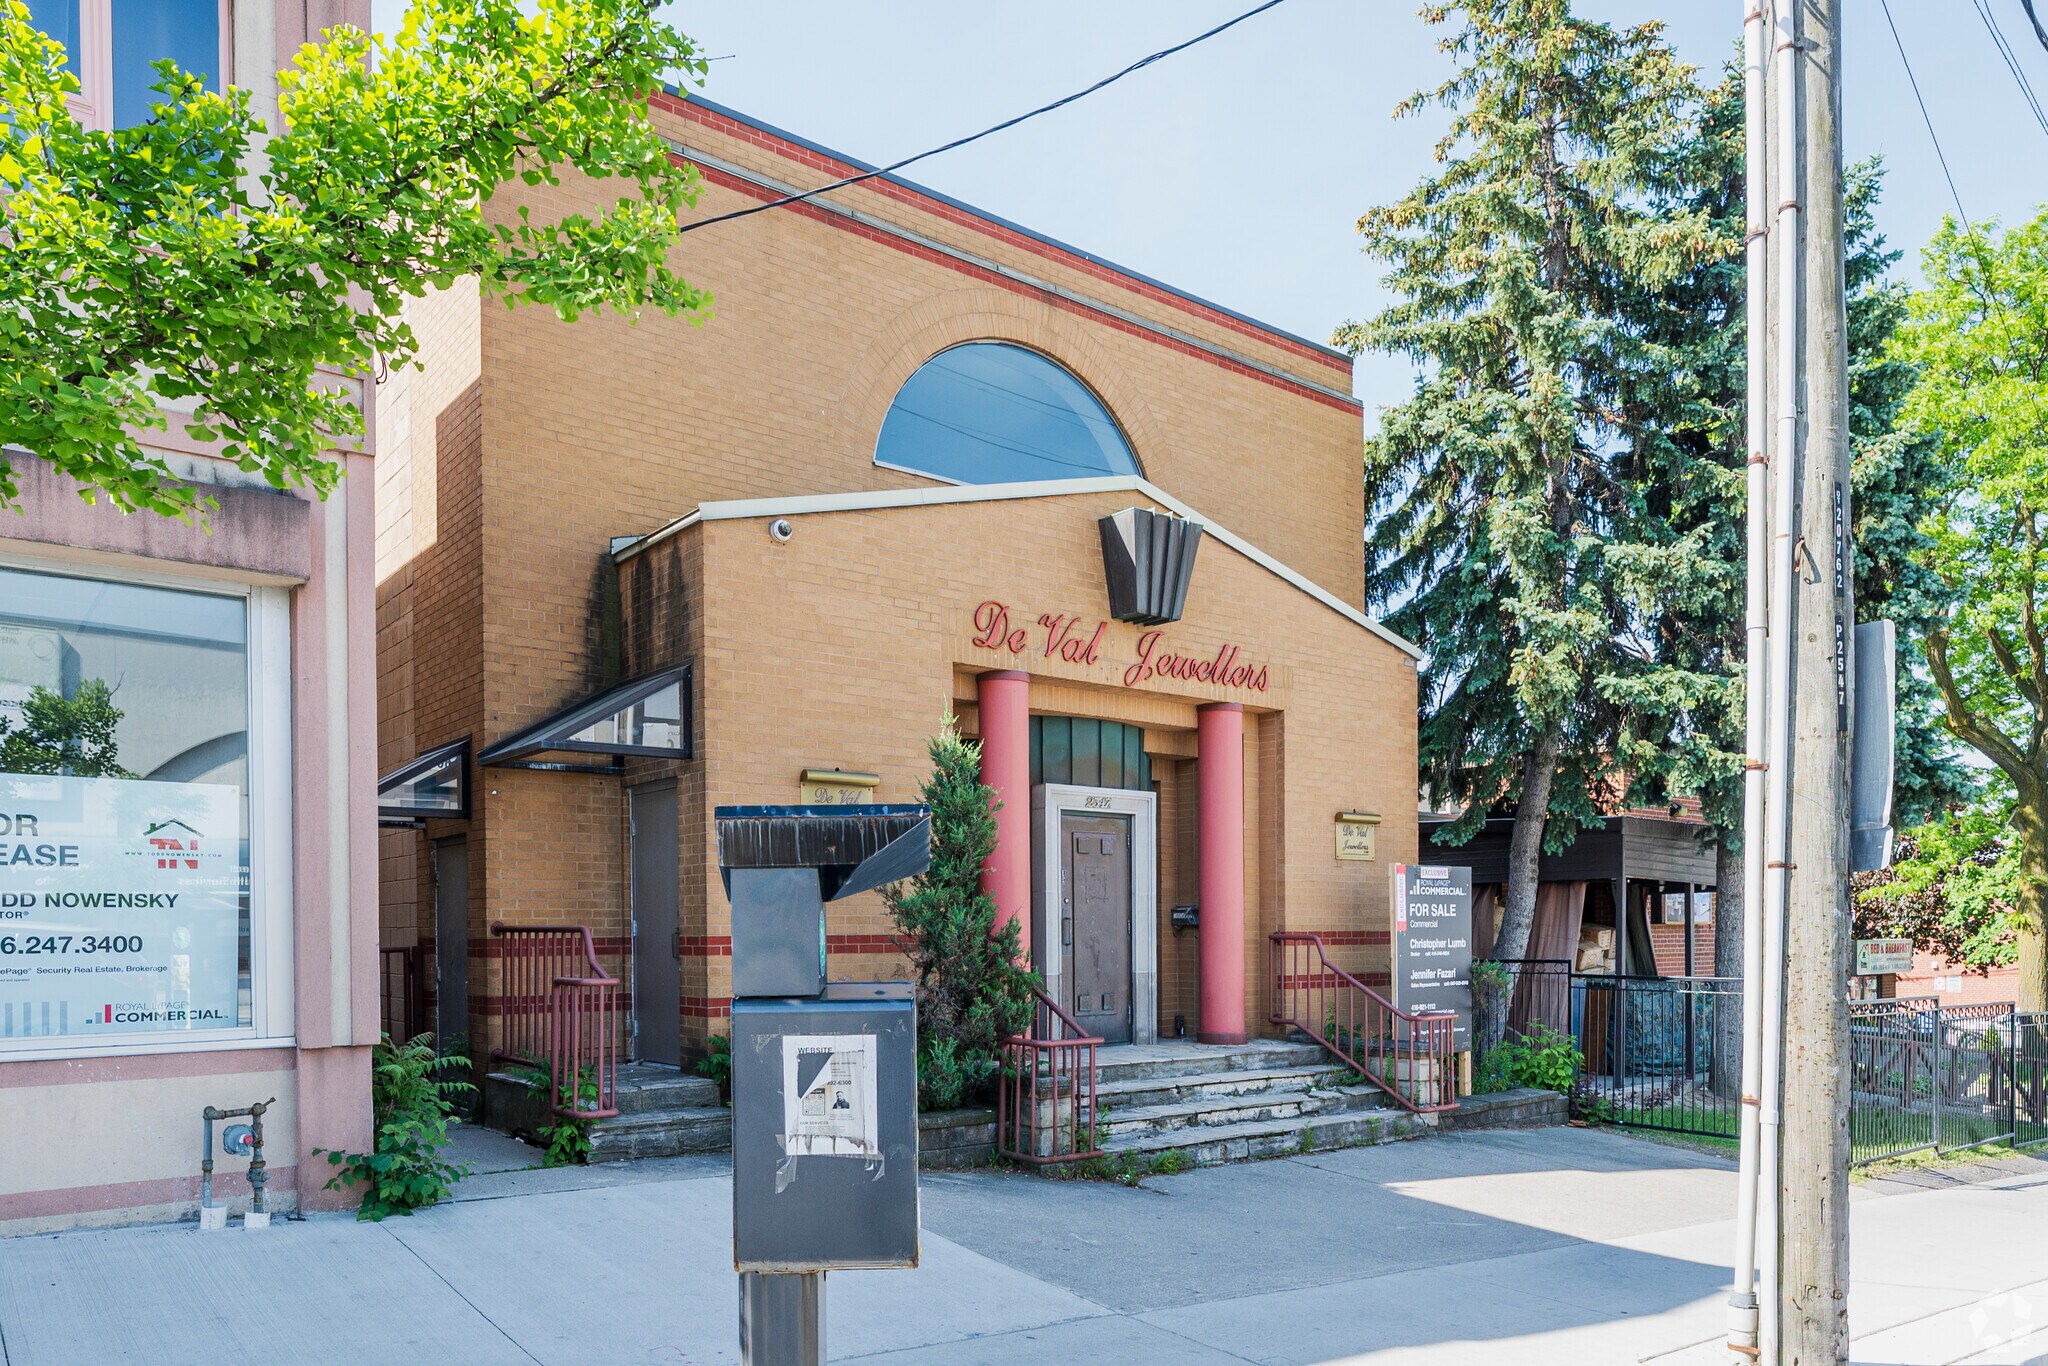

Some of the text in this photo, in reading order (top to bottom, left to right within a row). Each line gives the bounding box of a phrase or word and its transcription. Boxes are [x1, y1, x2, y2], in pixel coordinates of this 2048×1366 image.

[973, 600, 1270, 692] De Val Jewellers
[815, 787, 862, 805] De Val
[45, 892, 180, 908] NOWENSKY
[1409, 903, 1457, 917] FOR SALE
[1410, 919, 1438, 928] Commercial
[0, 935, 144, 955] 6.247.3400
[1409, 937, 1467, 951] Christopher Lumb
[1870, 943, 1879, 954] BED
[36, 967, 72, 975] Security
[74, 966, 93, 974] Real
[95, 965, 124, 974] Estate,
[126, 964, 168, 973] Brokerage
[1410, 968, 1457, 980] Jennifer Fazari
[115, 1002, 149, 1012] ROYAL
[797, 1046, 833, 1054] WEBSITE
